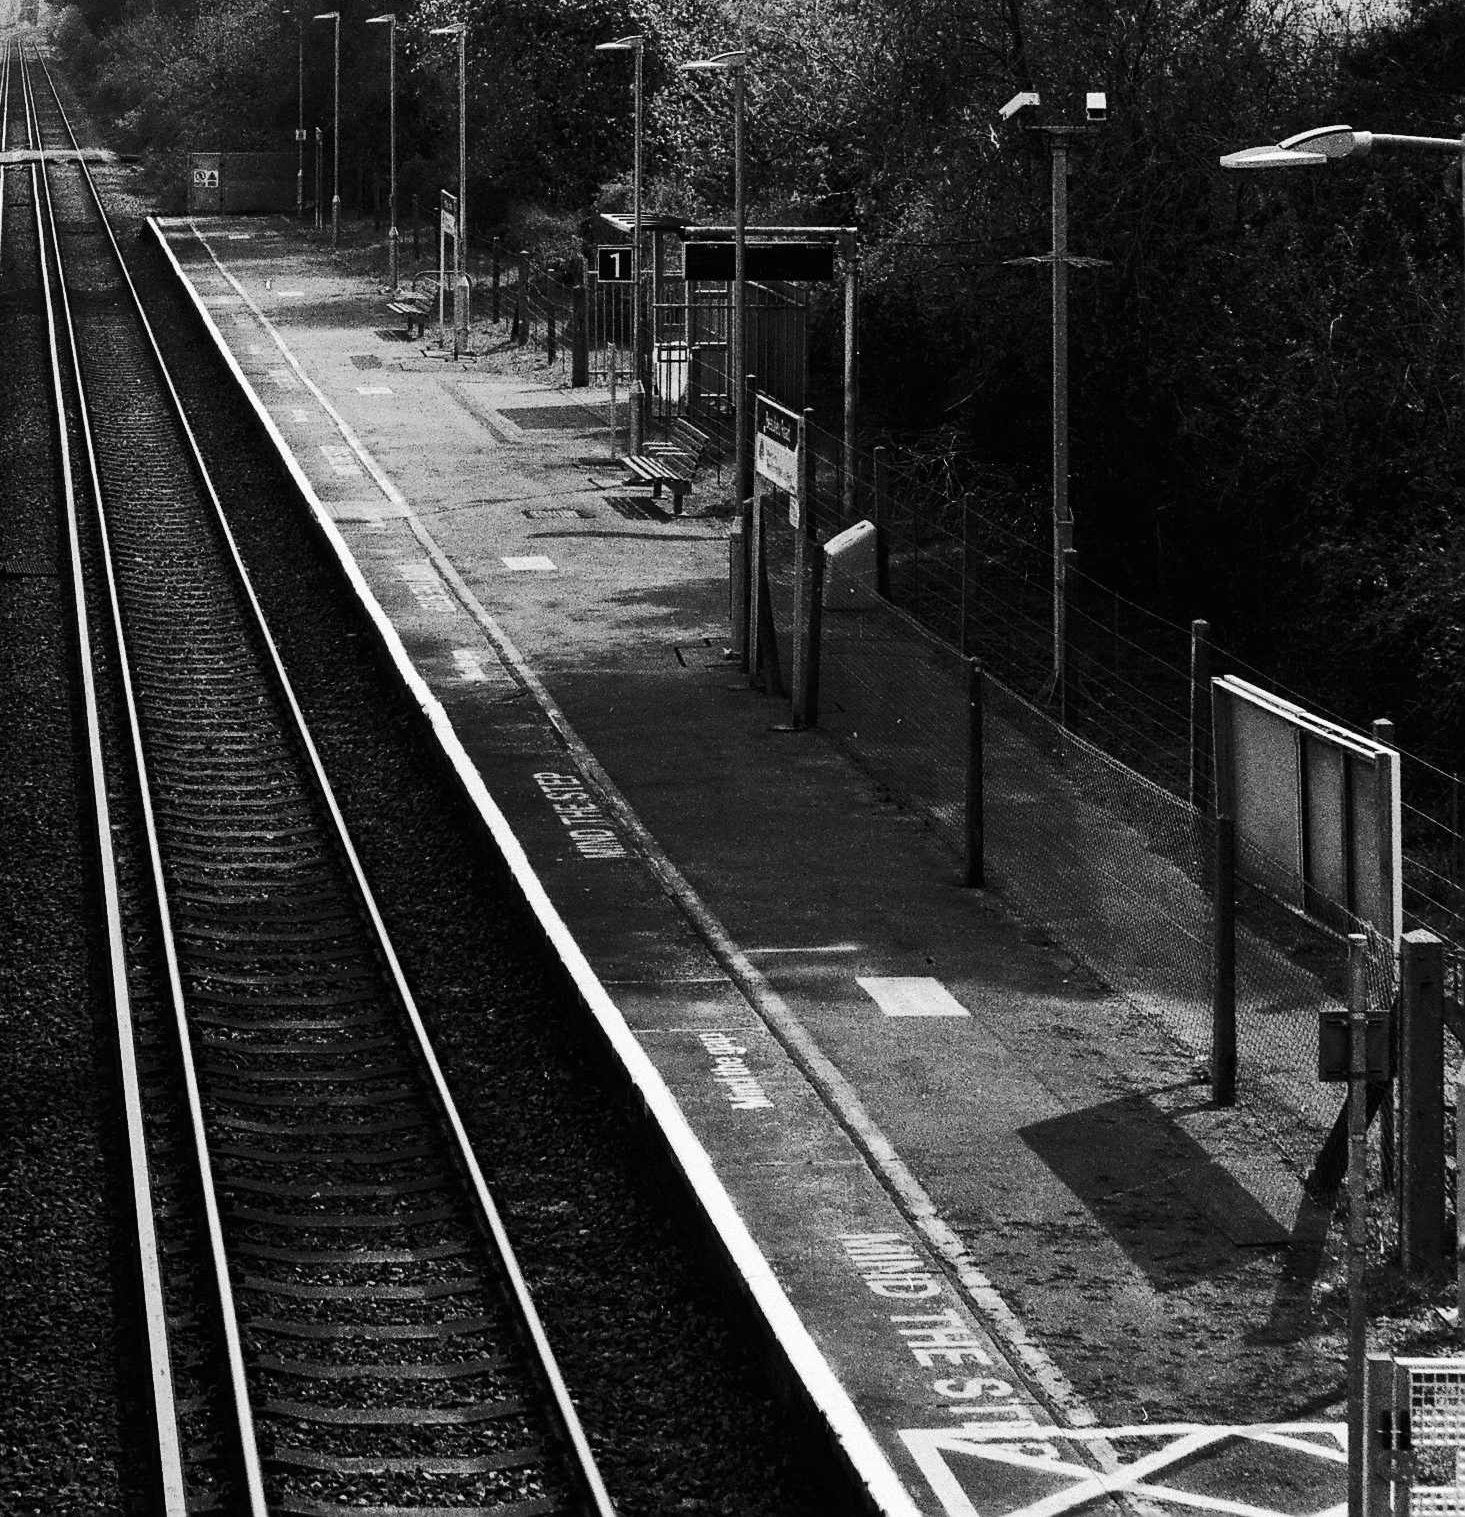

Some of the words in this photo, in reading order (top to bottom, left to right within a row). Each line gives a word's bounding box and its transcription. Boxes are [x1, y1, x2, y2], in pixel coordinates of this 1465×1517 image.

[610, 252, 620, 278] 1
[533, 772, 589, 800] STEP
[553, 803, 604, 825] THE
[569, 829, 627, 859] MIND
[697, 1032, 747, 1055] gap
[710, 1056, 751, 1076] the
[712, 1077, 775, 1110] Mind
[836, 1232, 942, 1299] MIND
[889, 1307, 996, 1367] THE
